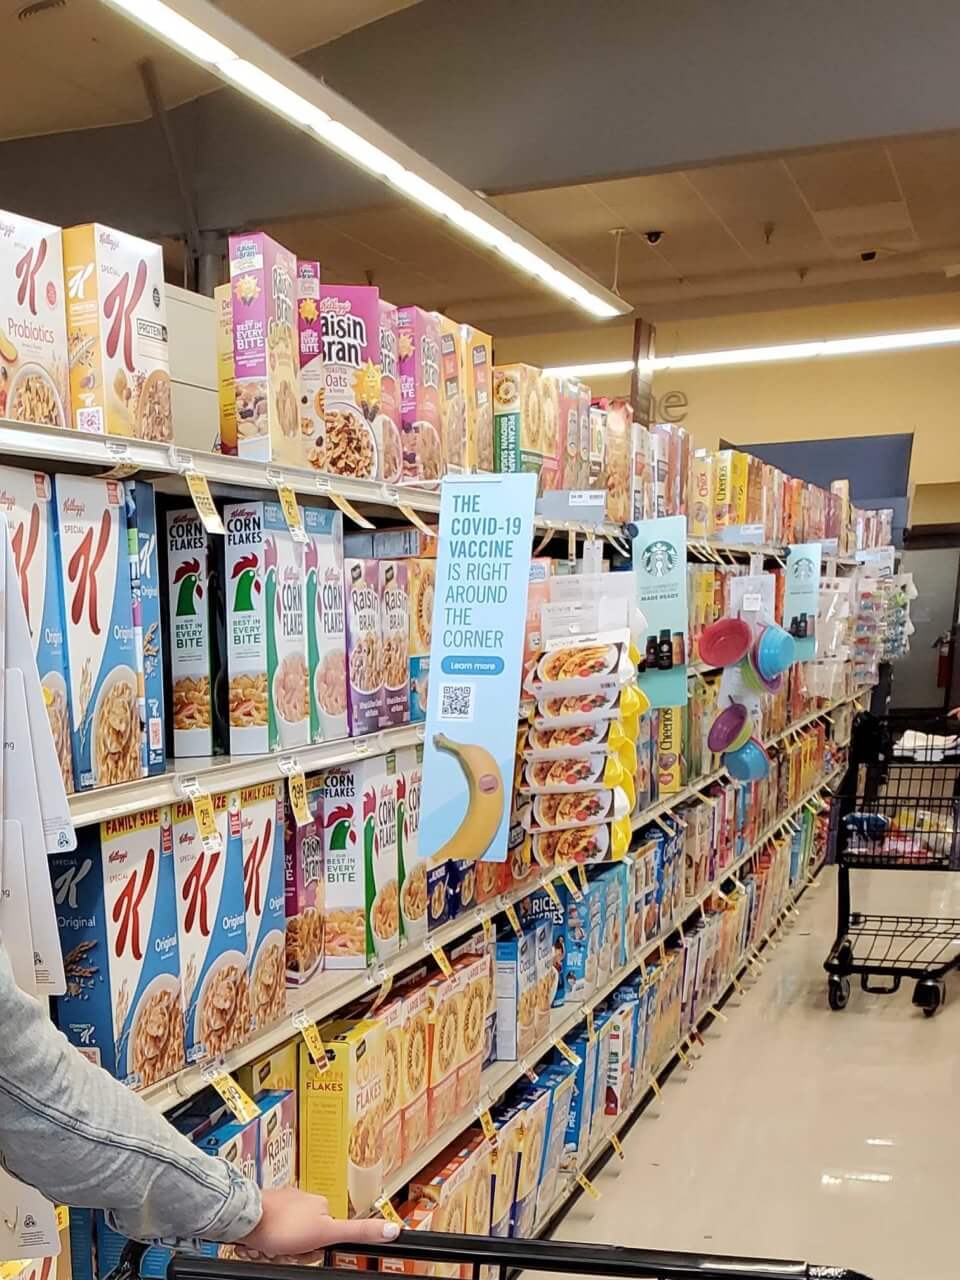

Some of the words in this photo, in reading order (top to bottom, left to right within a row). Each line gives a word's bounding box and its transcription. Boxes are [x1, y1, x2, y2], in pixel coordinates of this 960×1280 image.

[7, 317, 55, 345] Probiotics
[138, 322, 162, 337] PROTEIN
[321, 315, 365, 345] aisin
[237, 337, 265, 350] BITE
[325, 374, 348, 388] Oats
[453, 495, 481, 513] THE
[169, 522, 202, 539] CORN
[227, 516, 261, 534] CORN
[451, 517, 521, 536] COVID-19
[169, 536, 204, 552] FLAKES
[228, 531, 263, 547] FLAKES
[449, 540, 513, 558] VACCINE
[448, 563, 463, 581] IS
[466, 563, 510, 582] RIGHT
[282, 584, 303, 611] CORN
[323, 584, 343, 611] CORN
[445, 585, 508, 604] AROUND
[641, 594, 658, 602] MADE
[659, 592, 679, 601] READY
[233, 619, 251, 628] BEST
[253, 618, 261, 627] IN
[283, 612, 304, 636] FLAKES
[323, 611, 344, 636] FLAKES
[445, 607, 472, 626] THE
[176, 630, 203, 639] EVERY
[233, 625, 261, 635] EVERY
[443, 629, 504, 648] CORNER
[176, 637, 203, 650] BITE
[234, 633, 262, 646] BITE
[450, 660, 471, 671] Learn
[472, 662, 496, 671] more
[324, 774, 355, 788] CORN
[241, 789, 261, 803] FAMILY
[262, 784, 276, 799] SIZE
[324, 787, 356, 799] FLAKES
[106, 813, 139, 835] FAMILY
[139, 808, 160, 827] SIZE
[378, 800, 396, 828] CORN
[327, 858, 345, 866] BEST
[327, 865, 356, 873] EVERY
[328, 873, 356, 884] BITE
[112, 848, 155, 961] K
[57, 915, 97, 932] Original
[305, 1081, 344, 1092] FLAKES
